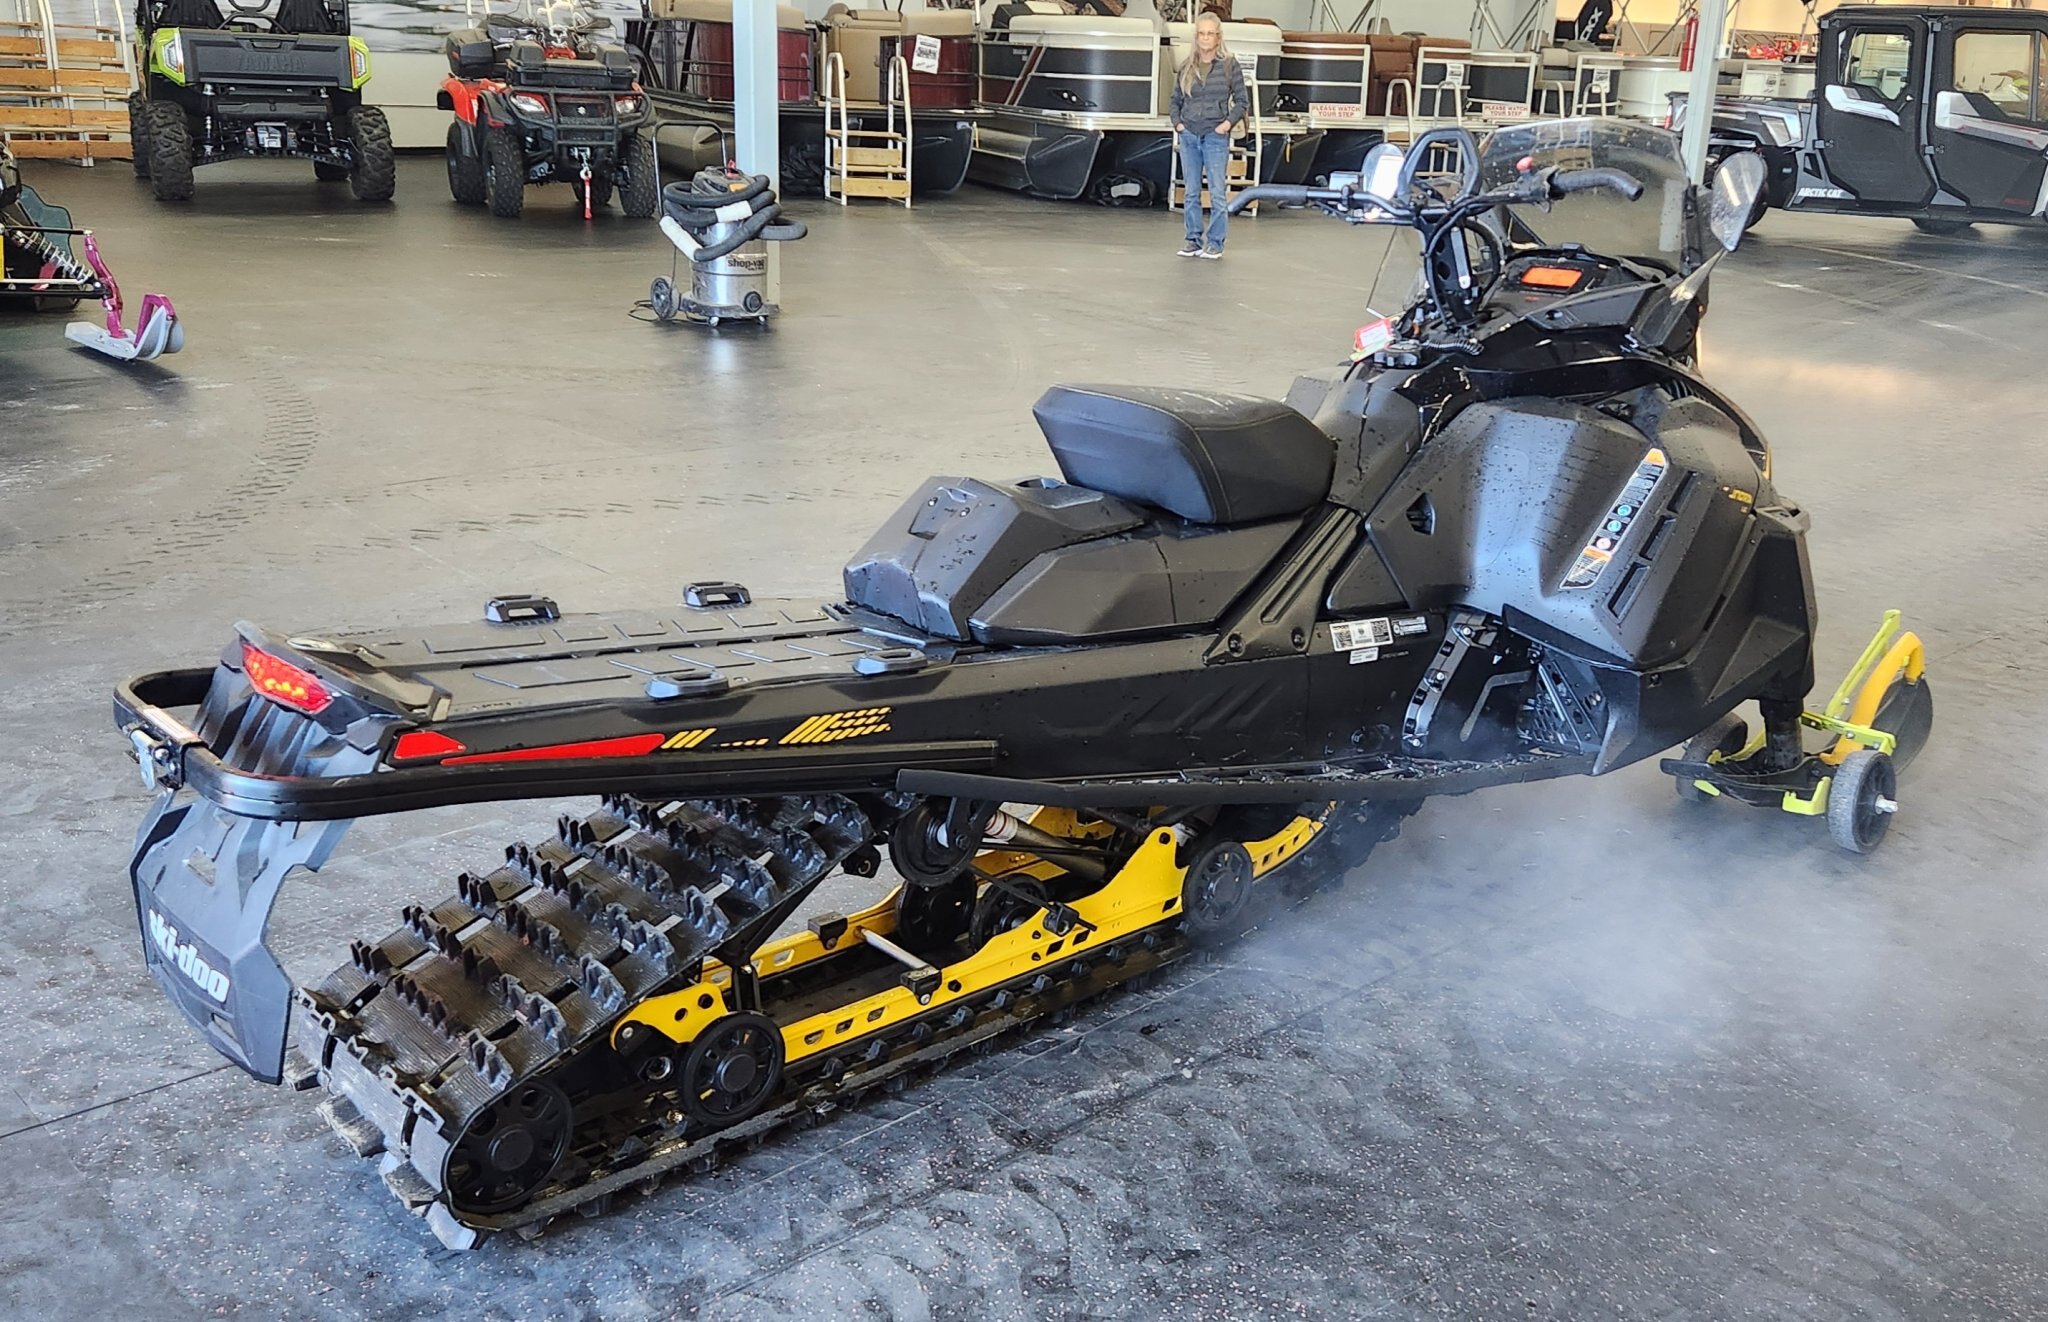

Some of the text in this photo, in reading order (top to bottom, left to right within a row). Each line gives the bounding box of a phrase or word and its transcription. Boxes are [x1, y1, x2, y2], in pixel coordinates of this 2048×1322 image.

[239, 54, 305, 73] YAMAHA
[1798, 188, 1842, 197] ARCTIC CAT
